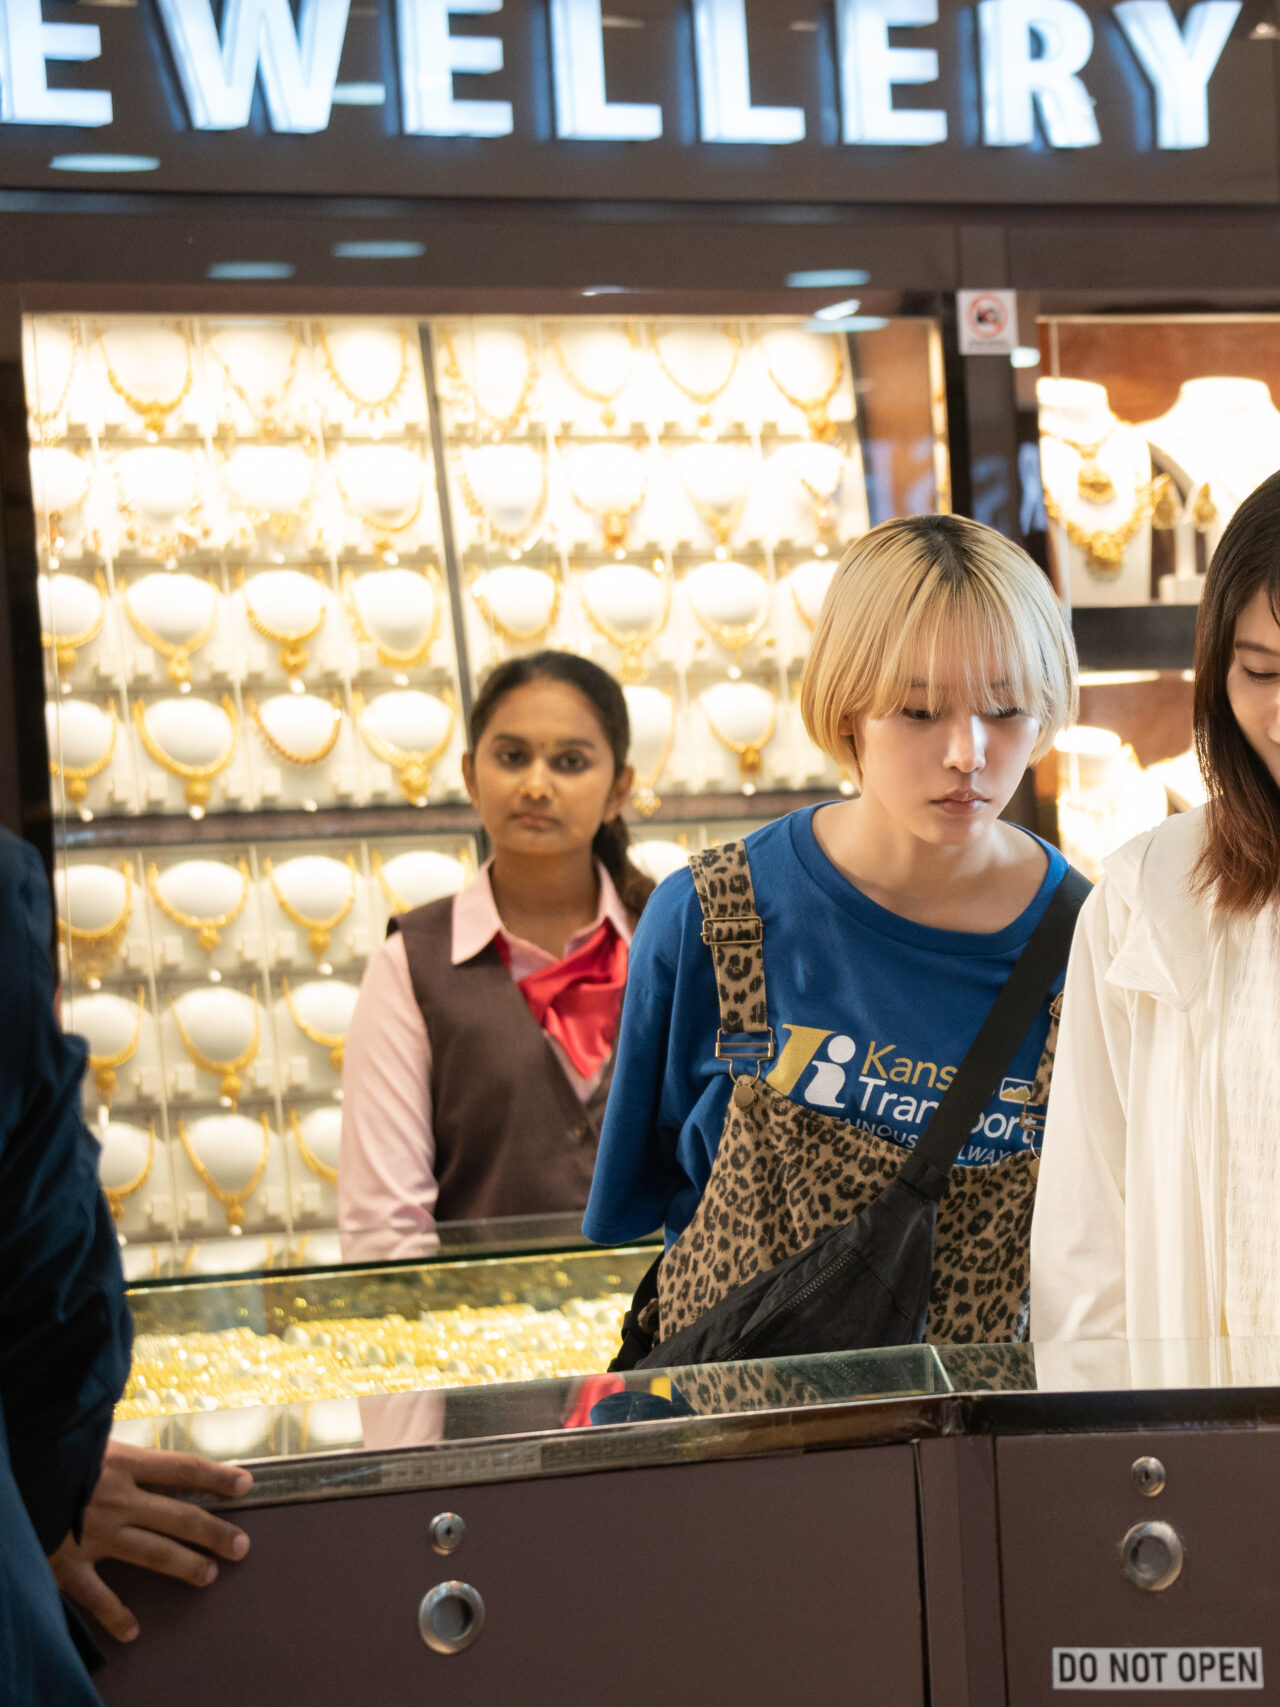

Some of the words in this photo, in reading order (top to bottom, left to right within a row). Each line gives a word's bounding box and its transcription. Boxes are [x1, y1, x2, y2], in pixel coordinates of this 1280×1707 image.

[861, 1041, 958, 1090] Kans
[1058, 1652, 1098, 1683] DO
[1109, 1652, 1168, 1683] NOT
[1177, 1651, 1258, 1683] OPEN
